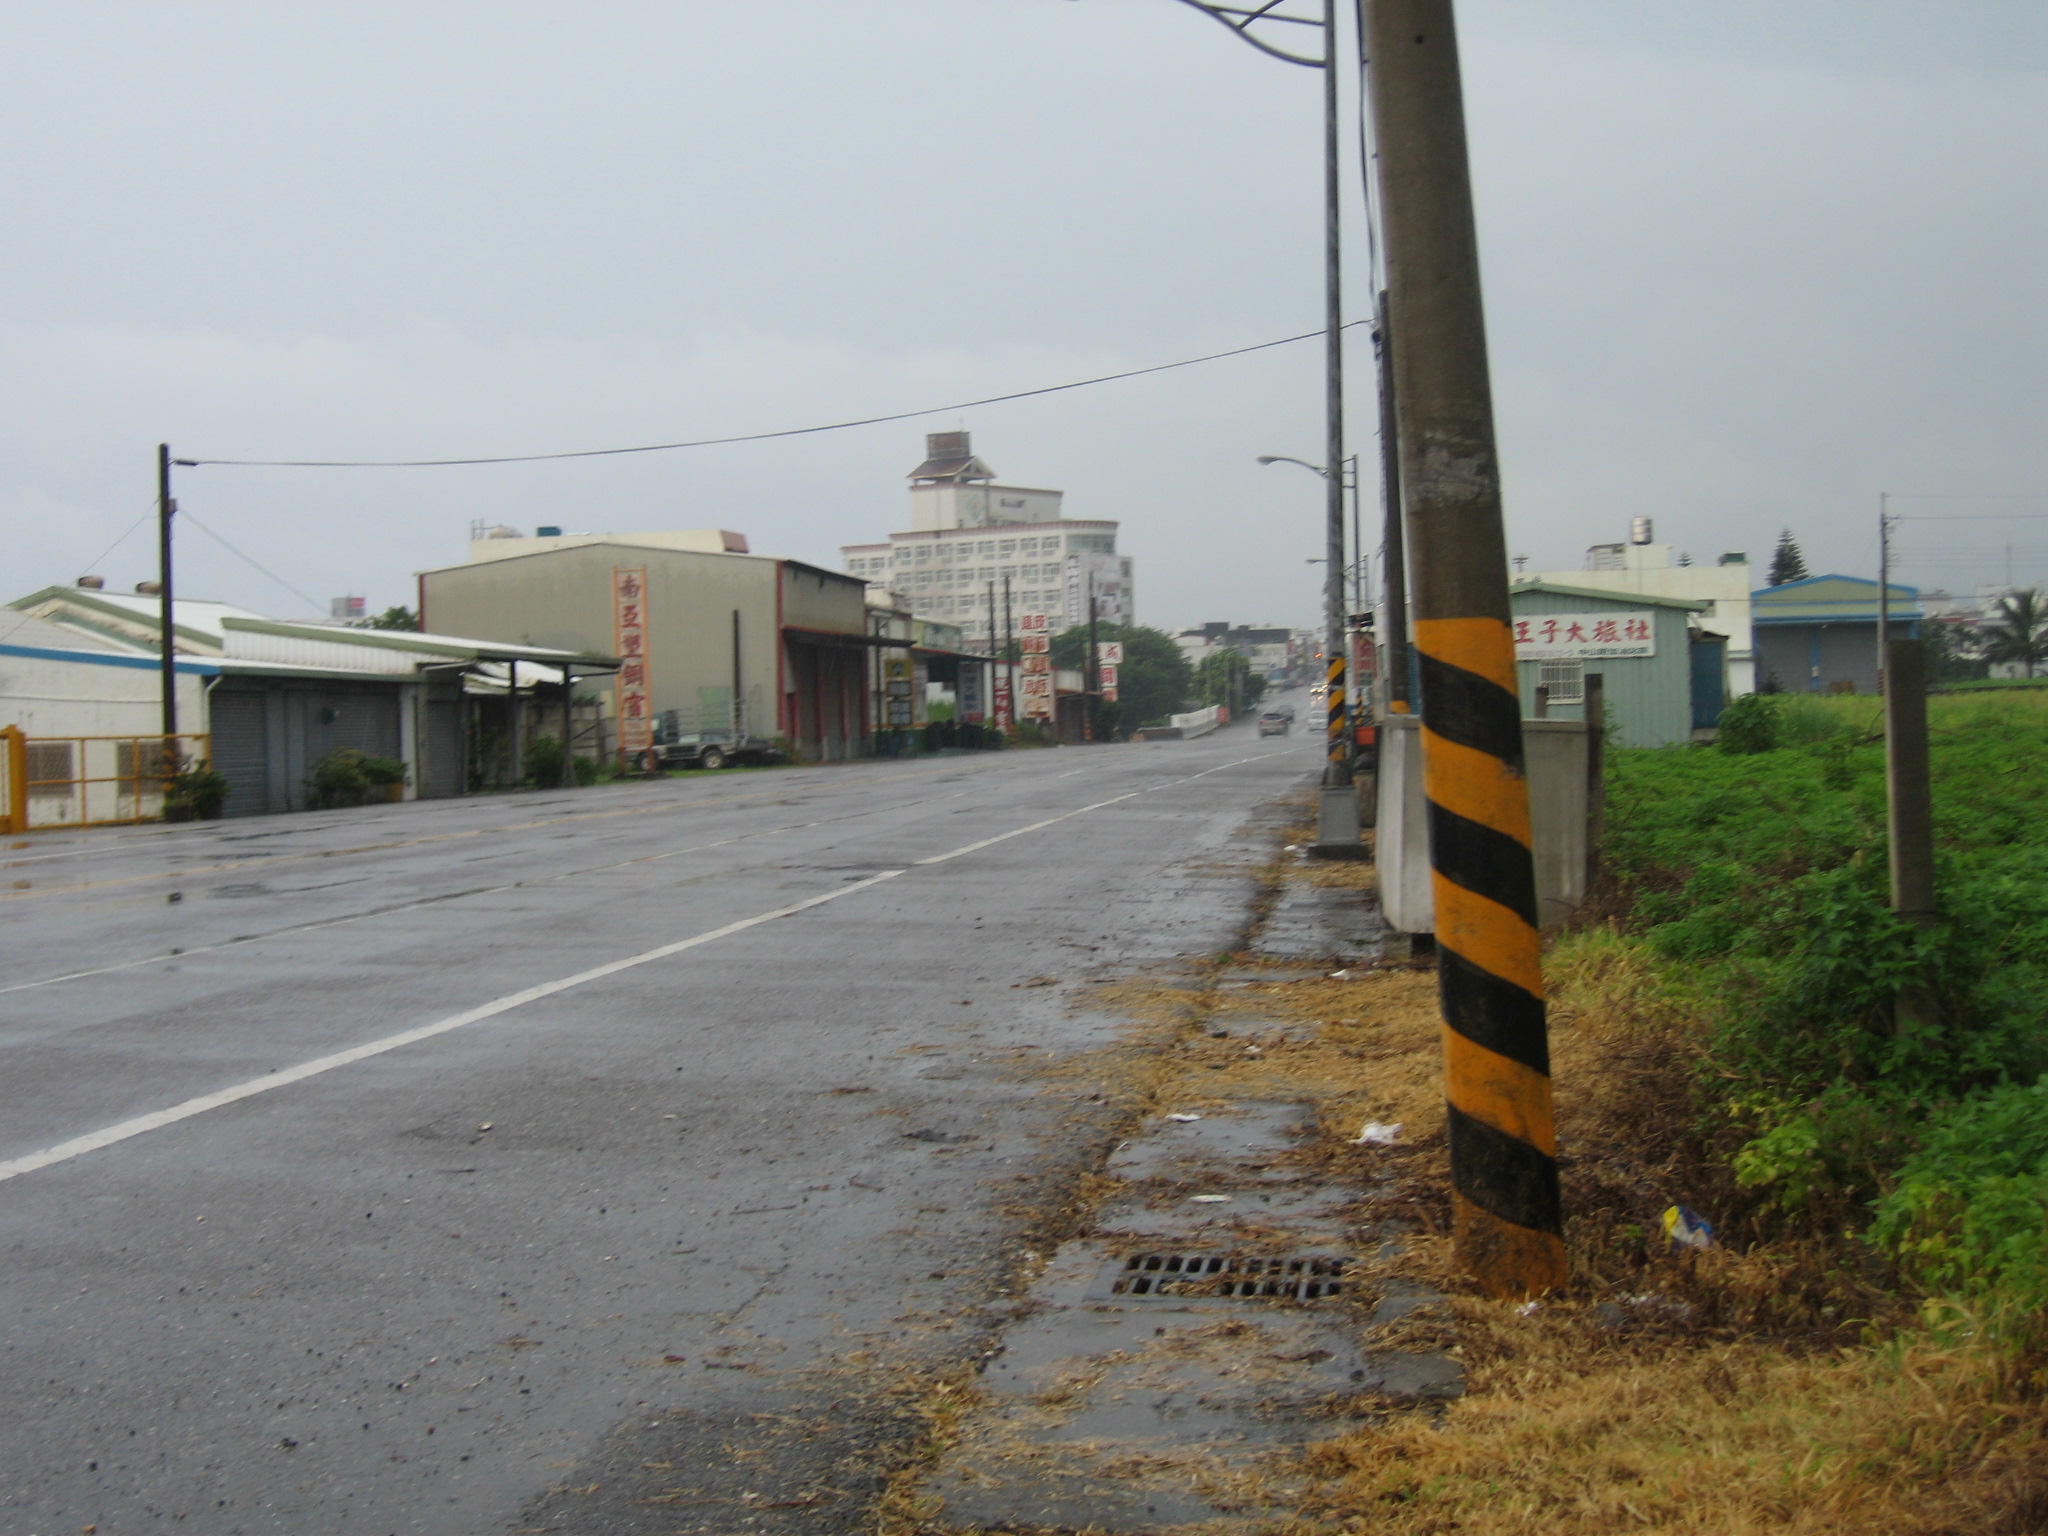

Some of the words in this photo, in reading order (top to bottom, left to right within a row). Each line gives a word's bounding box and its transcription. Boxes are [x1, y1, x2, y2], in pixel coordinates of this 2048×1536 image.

[1514, 618, 1651, 644] 王子大旅社
